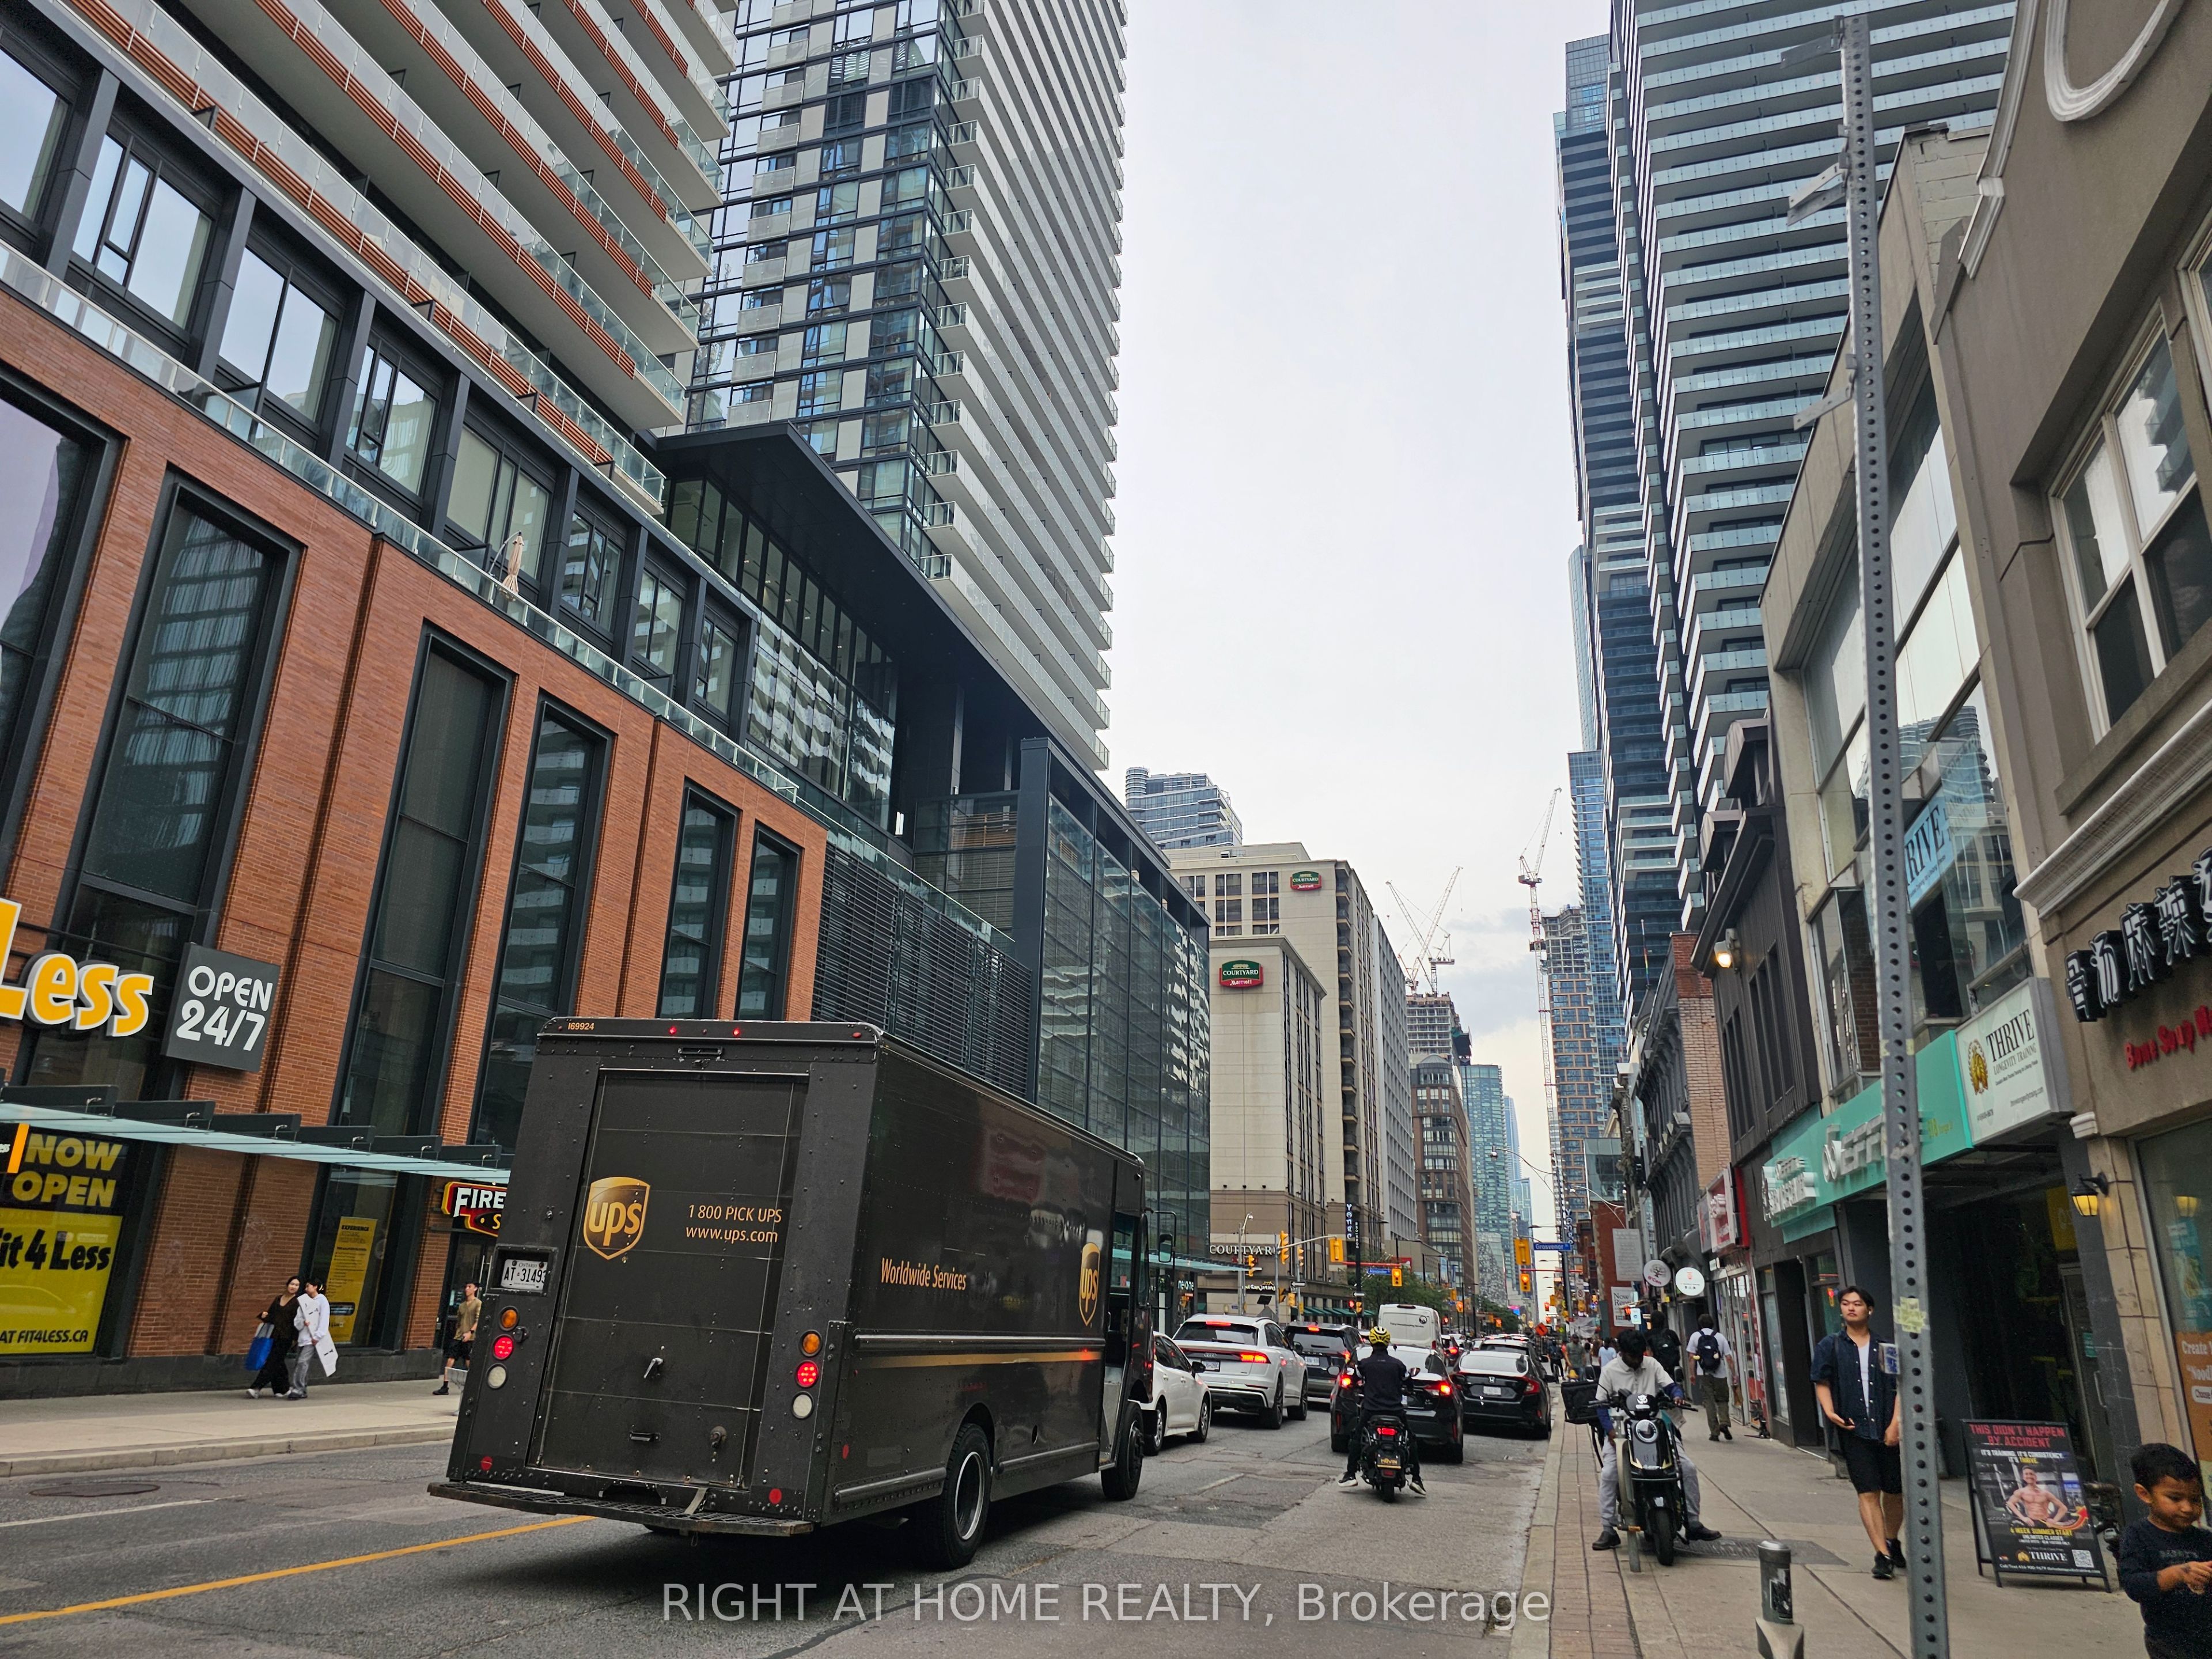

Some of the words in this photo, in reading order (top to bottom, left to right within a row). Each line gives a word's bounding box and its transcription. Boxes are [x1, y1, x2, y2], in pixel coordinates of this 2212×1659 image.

[1902, 804, 1945, 885] RIVE
[0, 897, 154, 1036] Less
[188, 965, 273, 1012] OPEN
[176, 999, 266, 1051] 24/7
[1986, 1009, 2035, 1062] THRIVE
[1993, 1058, 2016, 1075] LONGEVITY
[2017, 1046, 2037, 1064] TRAINING
[25, 1133, 123, 1171] NOW
[12, 1171, 116, 1207] OPEN
[588, 1202, 642, 1247] ups
[689, 1205, 695, 1218] 1
[698, 1205, 722, 1219] 800
[725, 1206, 753, 1221] PICK
[757, 1208, 782, 1223] UPS
[0, 1228, 24, 1269] it
[24, 1229, 47, 1270] 4
[49, 1230, 111, 1271] Less
[685, 1226, 778, 1244] www.ups.com
[504, 1267, 516, 1281] AT
[881, 1257, 930, 1287] Worldwide
[932, 1264, 967, 1290] Services
[1080, 1268, 1097, 1313] ups
[17, 1330, 88, 1343] FIT4LESS.CA
[1969, 1424, 1990, 1434] THIS
[2025, 1426, 2065, 1438] HAPPEN
[2004, 1436, 2051, 1448] ACCIDENT
[2029, 1551, 2069, 1562] THRIVE
